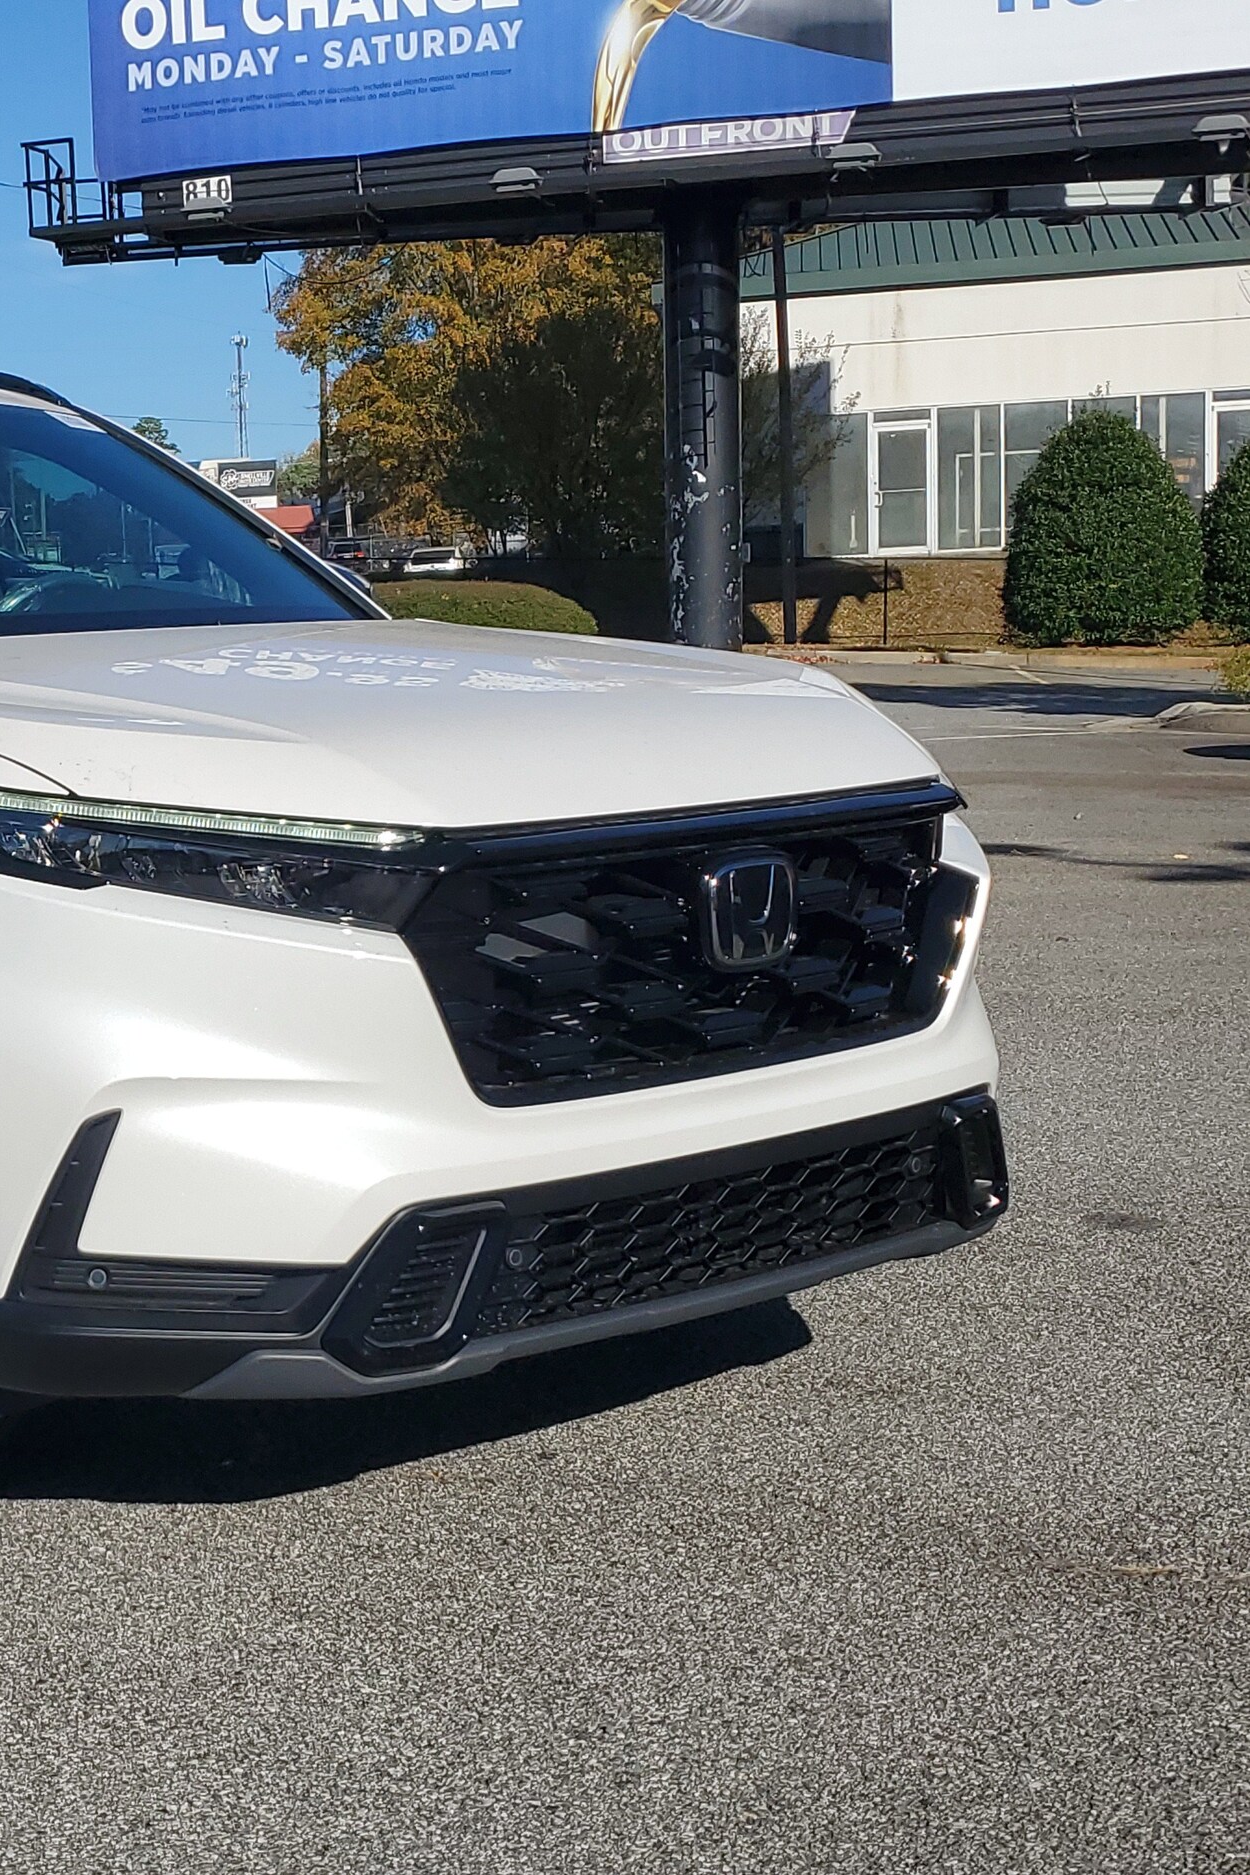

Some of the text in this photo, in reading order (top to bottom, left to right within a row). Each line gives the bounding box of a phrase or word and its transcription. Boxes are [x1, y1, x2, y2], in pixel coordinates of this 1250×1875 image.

[121, 0, 519, 50] OIL CHA
[127, 46, 280, 92] MONDAY
[323, 20, 524, 70] SATURDAY
[611, 112, 832, 156] OUTFRONT
[185, 178, 231, 202] 810
